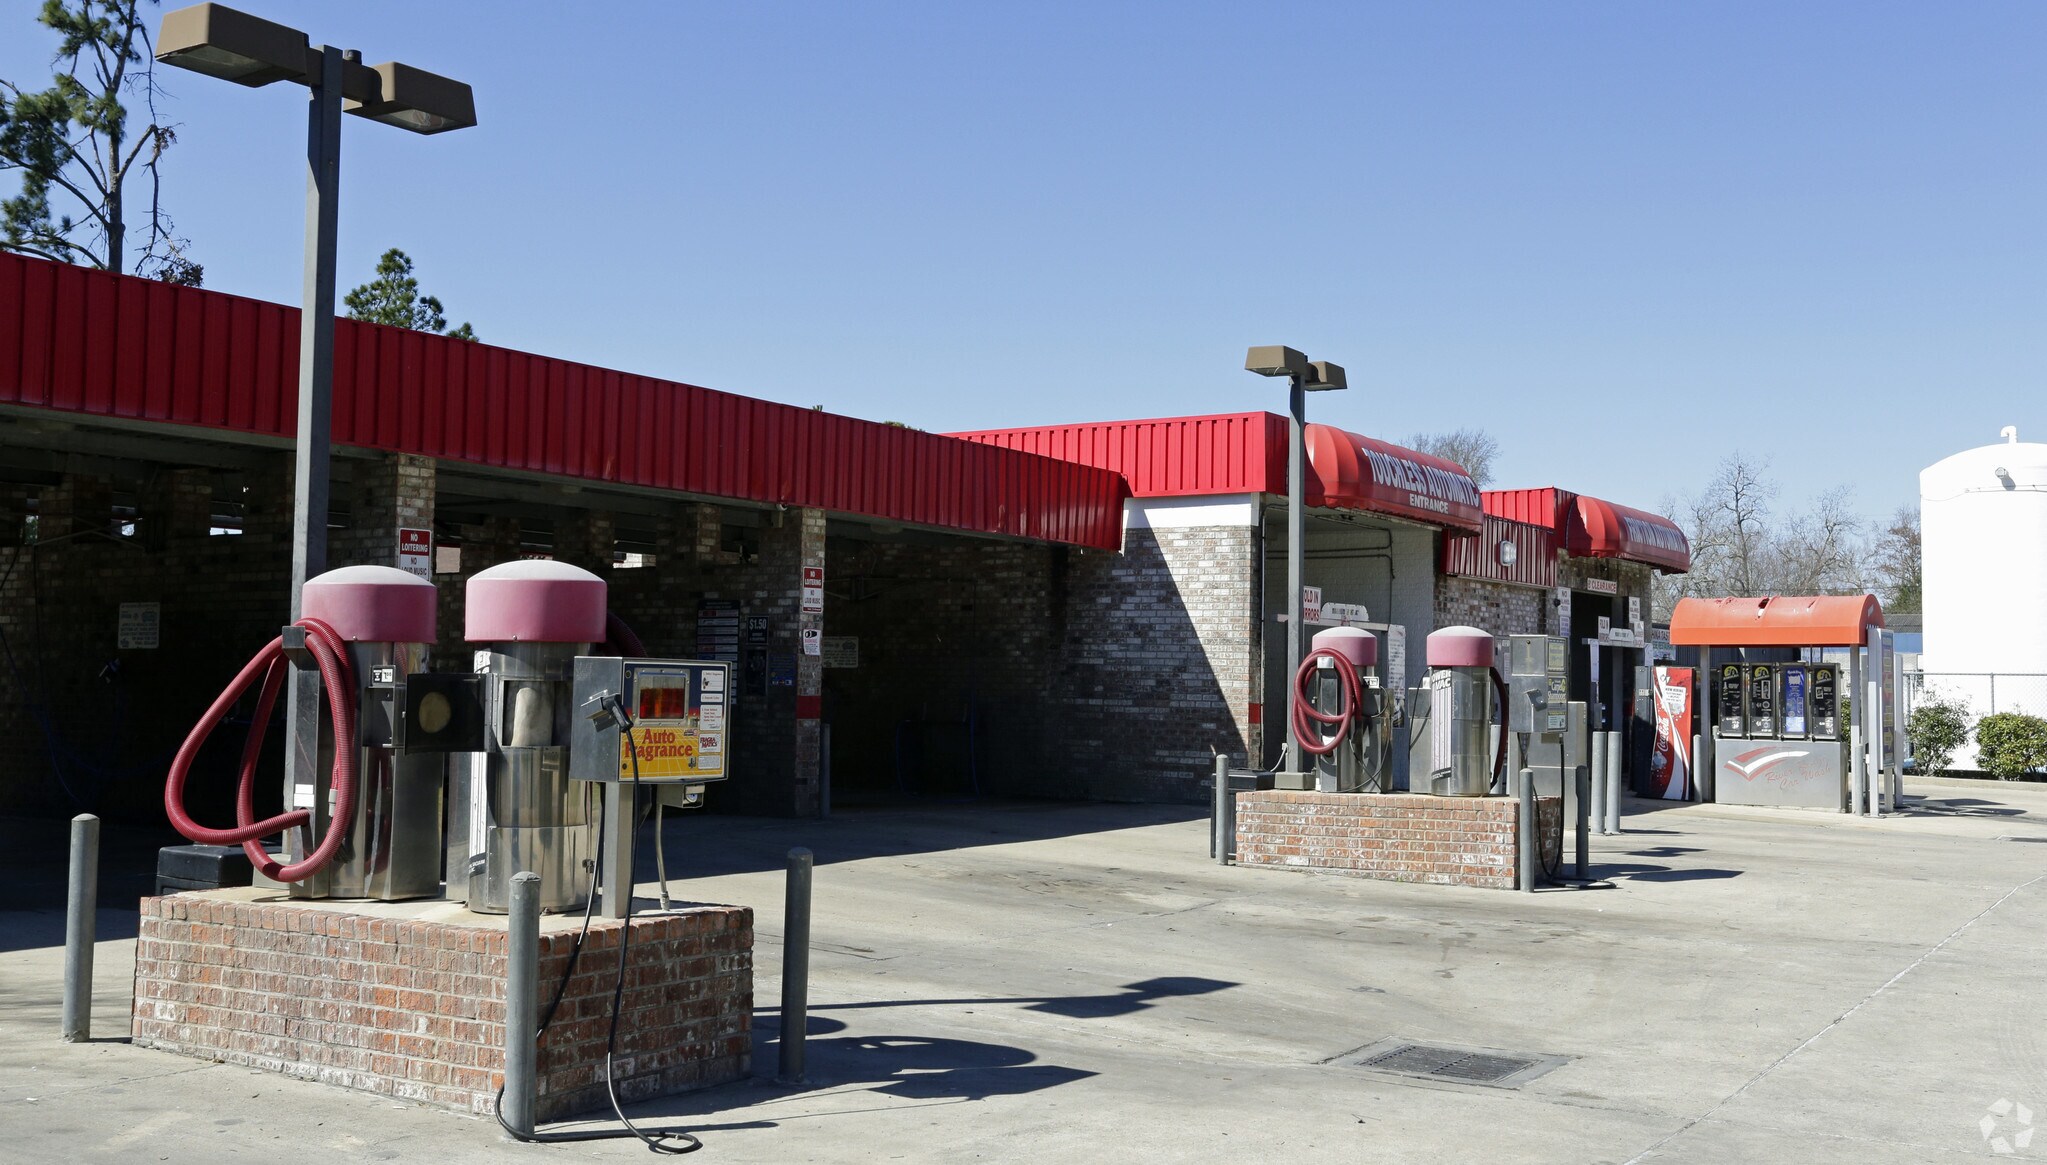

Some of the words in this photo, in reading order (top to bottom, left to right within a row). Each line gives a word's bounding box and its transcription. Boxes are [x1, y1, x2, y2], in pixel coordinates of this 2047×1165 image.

[1362, 448, 1427, 494] TOUCHLESS
[1422, 464, 1480, 507] AUTOMATIC
[1409, 493, 1449, 514] ENTRANCE
[410, 533, 419, 542] NO
[401, 543, 428, 553] LOITERING
[410, 557, 418, 565] NO
[413, 567, 427, 575] MUSIC
[1592, 581, 1616, 593] CLEARANCE
[1304, 589, 1313, 603] OLD
[1314, 591, 1319, 604] IN
[1303, 607, 1320, 622] RRORS
[1435, 678, 1451, 690] VAC
[642, 729, 675, 744] Auto
[624, 742, 693, 761] Fagrance
